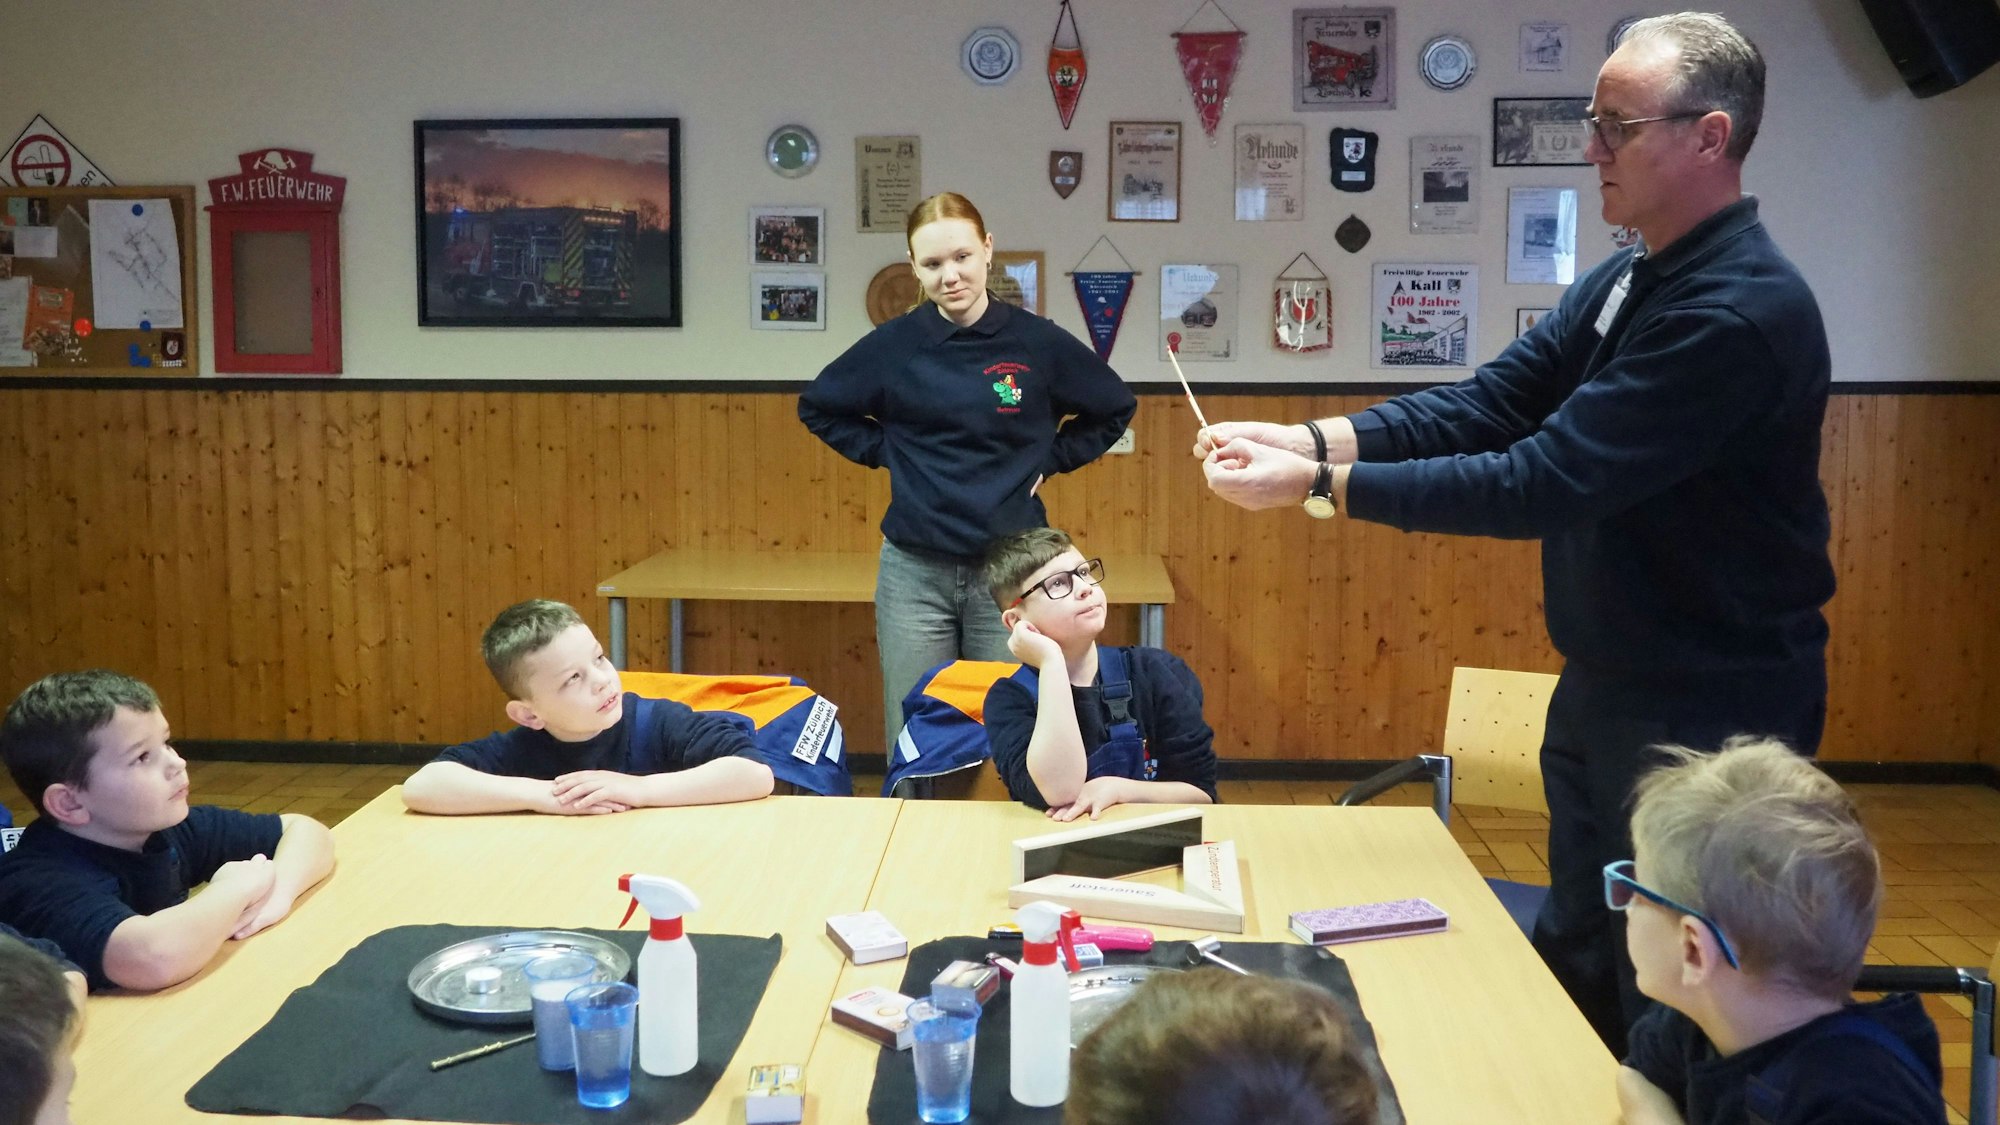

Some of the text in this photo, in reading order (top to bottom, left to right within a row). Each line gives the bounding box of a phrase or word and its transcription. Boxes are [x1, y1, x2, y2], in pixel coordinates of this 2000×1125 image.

[1244, 134, 1299, 160] Urkunde
[1383, 269, 1470, 277] Freiwillige Feuerwehr
[1411, 280, 1442, 291] Kall
[1390, 296, 1461, 307] 100 Jahre
[796, 700, 827, 756] FFW Zülpich
[805, 706, 835, 761] Kinderfeuerwehr
[1068, 882, 1157, 897] Sauerstoff
